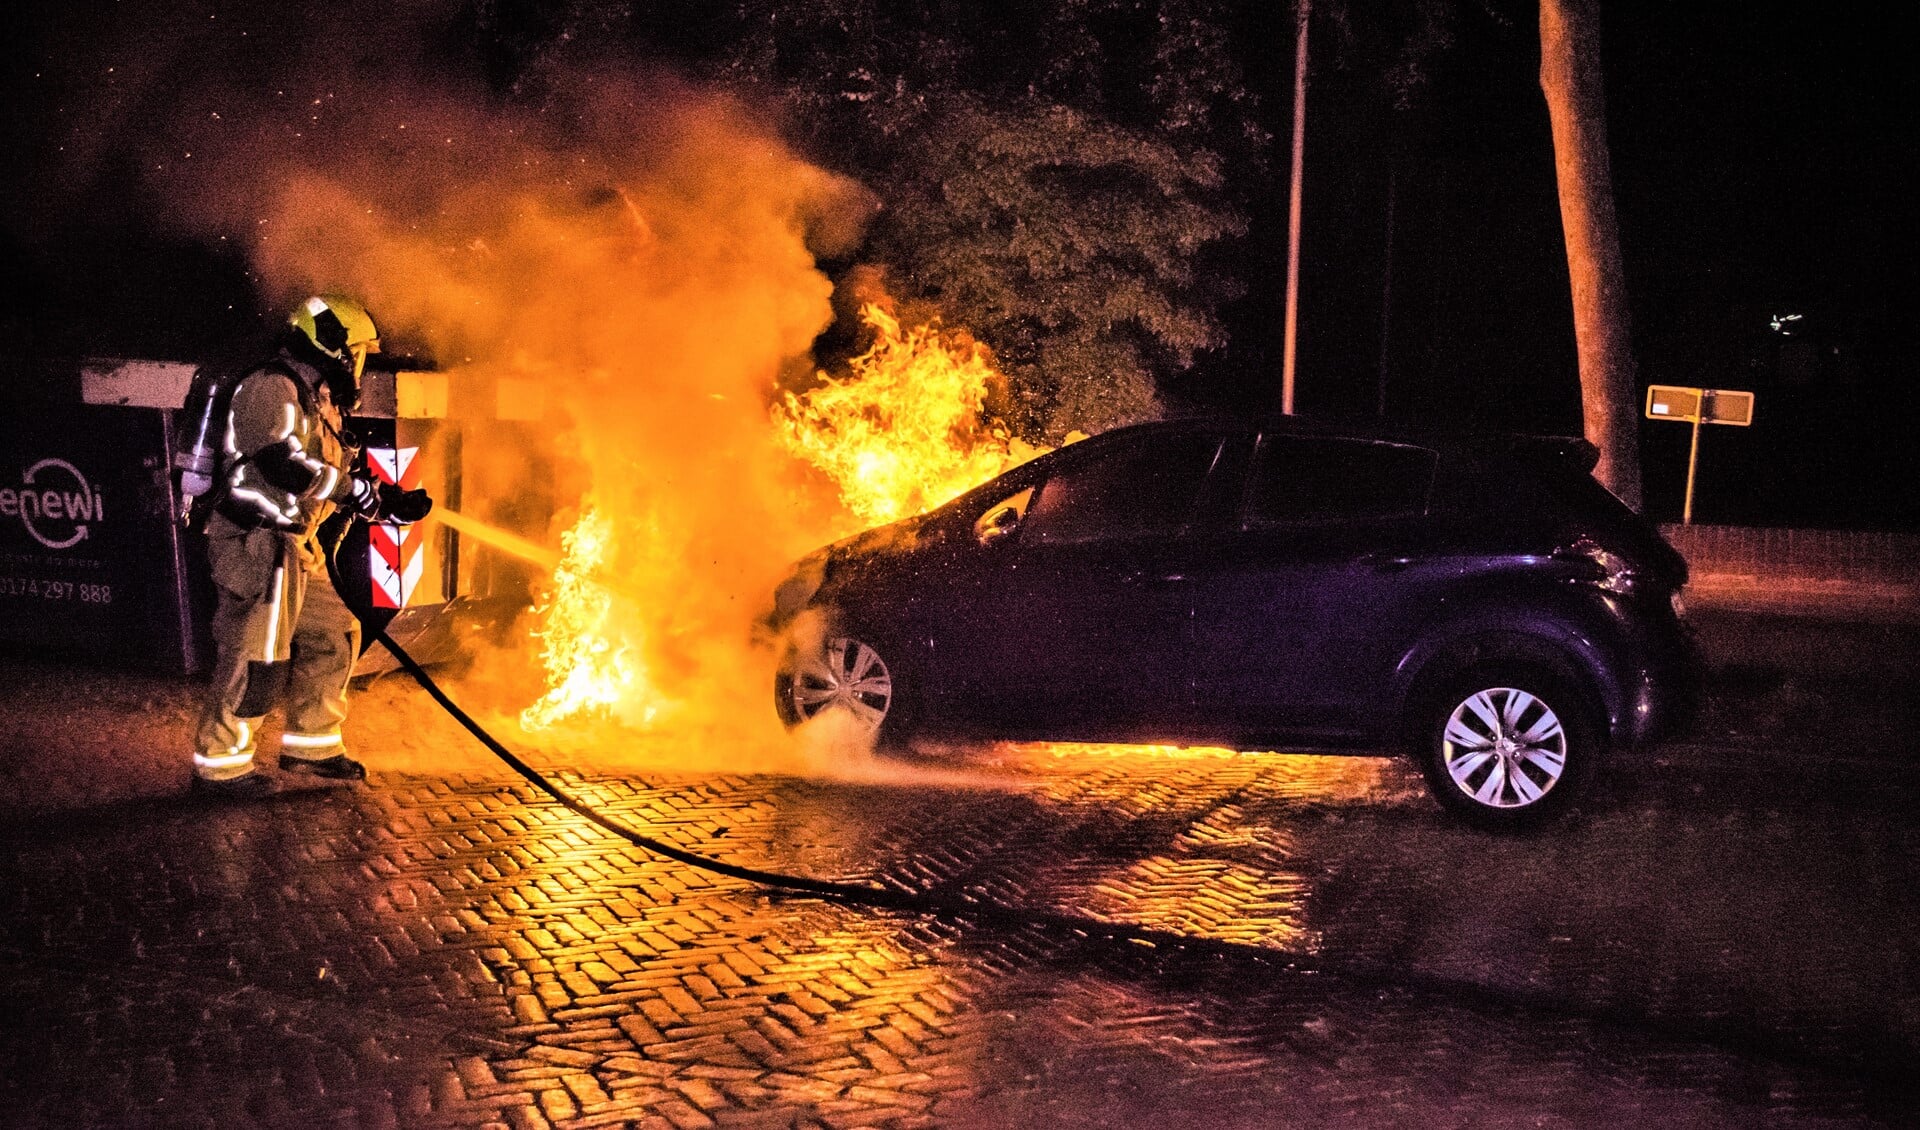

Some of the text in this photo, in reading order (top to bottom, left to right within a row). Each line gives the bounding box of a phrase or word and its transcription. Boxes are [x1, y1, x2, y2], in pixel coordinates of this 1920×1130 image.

[0, 577, 112, 603] 0174 297 888
